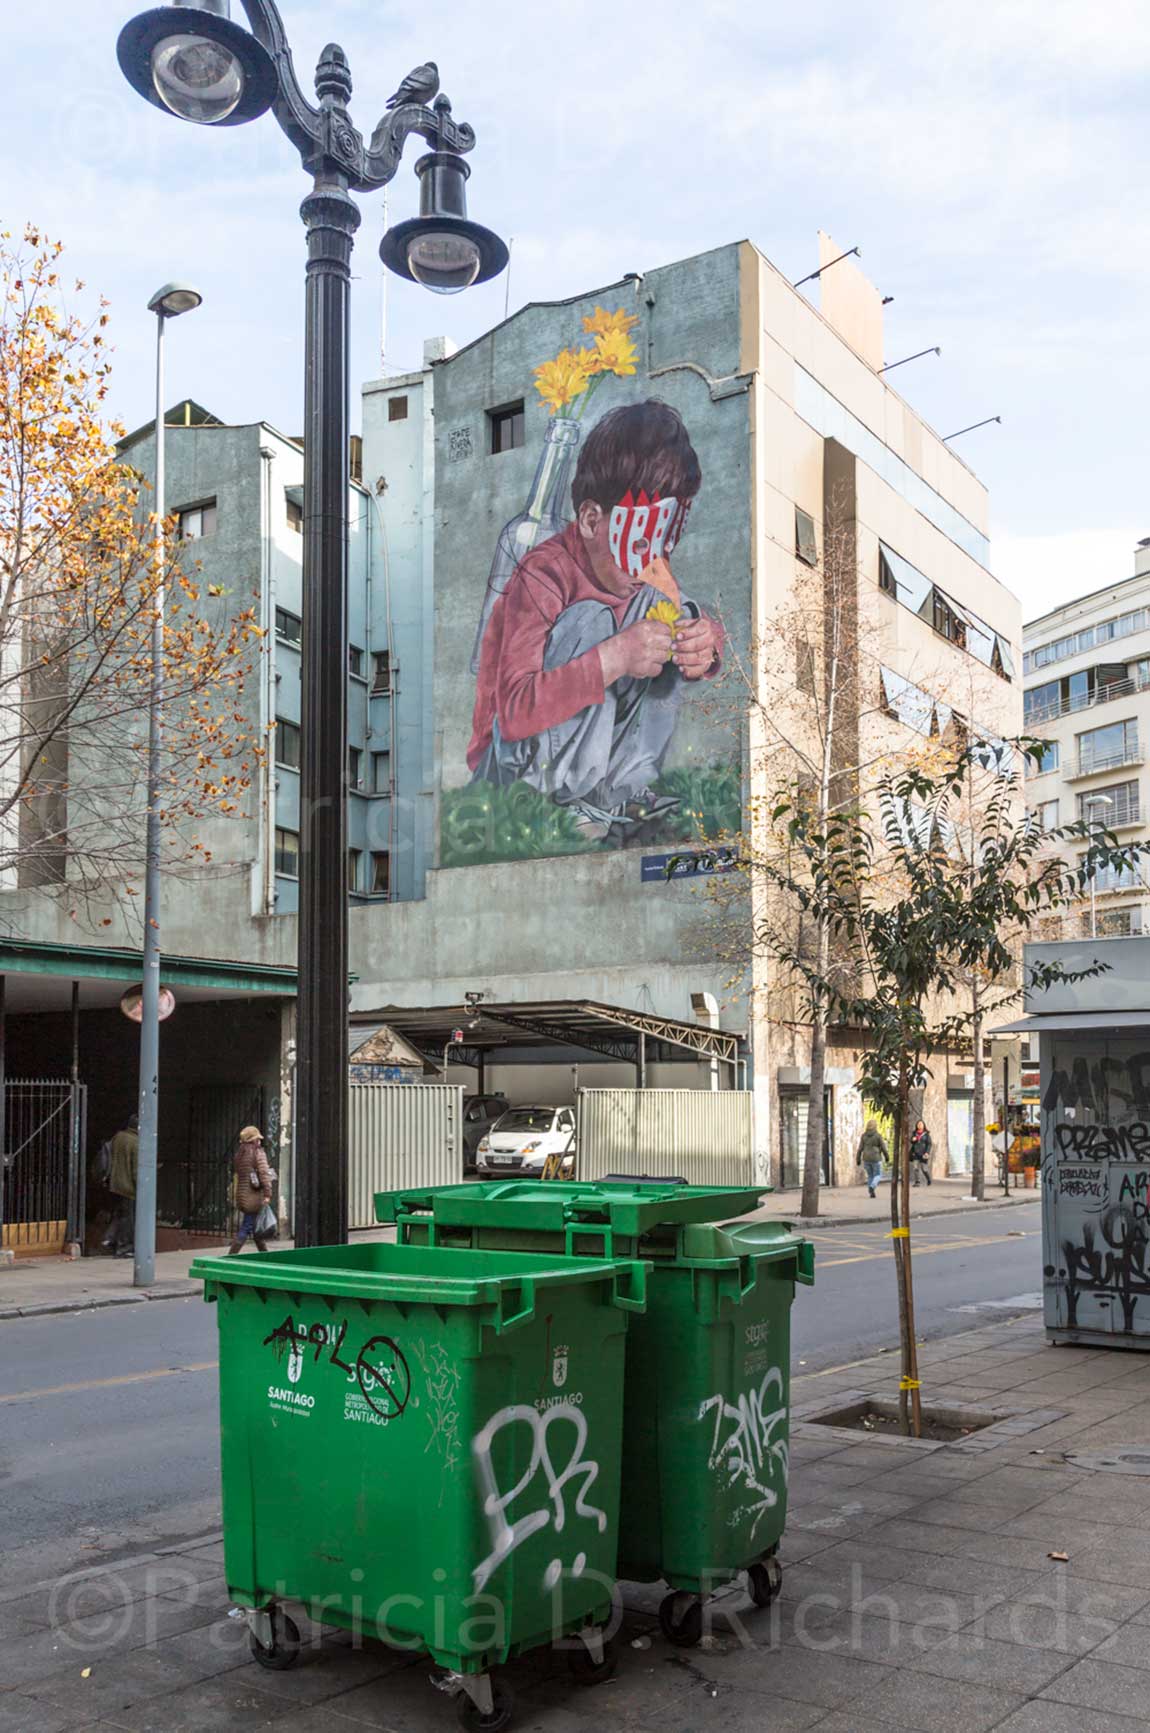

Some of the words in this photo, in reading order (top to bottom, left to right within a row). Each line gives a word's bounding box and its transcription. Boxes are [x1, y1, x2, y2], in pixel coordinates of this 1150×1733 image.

[267, 1386, 316, 1408] SANTIAGO
[533, 1392, 584, 1411] SANTIAGO
[344, 1408, 389, 1427] SANTIAGO
